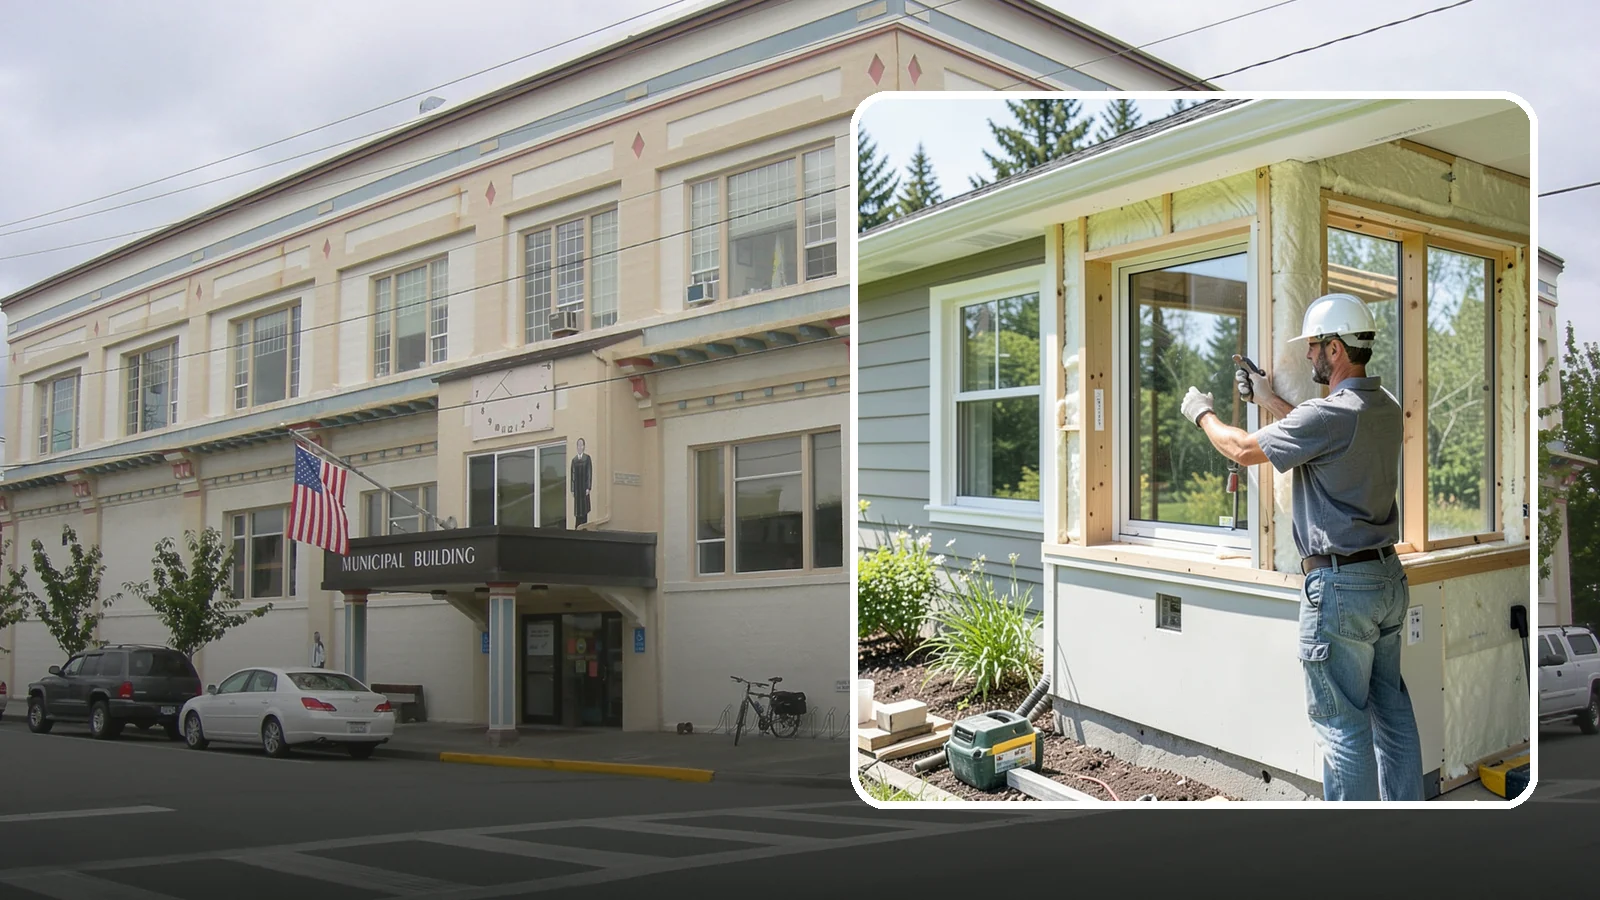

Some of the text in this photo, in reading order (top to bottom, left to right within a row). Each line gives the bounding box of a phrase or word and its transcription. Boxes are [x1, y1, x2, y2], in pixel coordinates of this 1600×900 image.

[536, 402, 540, 410] 4
[480, 407, 485, 415] 8
[487, 417, 492, 426] 9
[528, 414, 533, 422] 3
[494, 423, 500, 431] 10
[521, 420, 525, 428] 2
[501, 425, 506, 433] 11
[507, 425, 513, 433] 12
[342, 546, 476, 572] MUNICIPAL BUILDING
